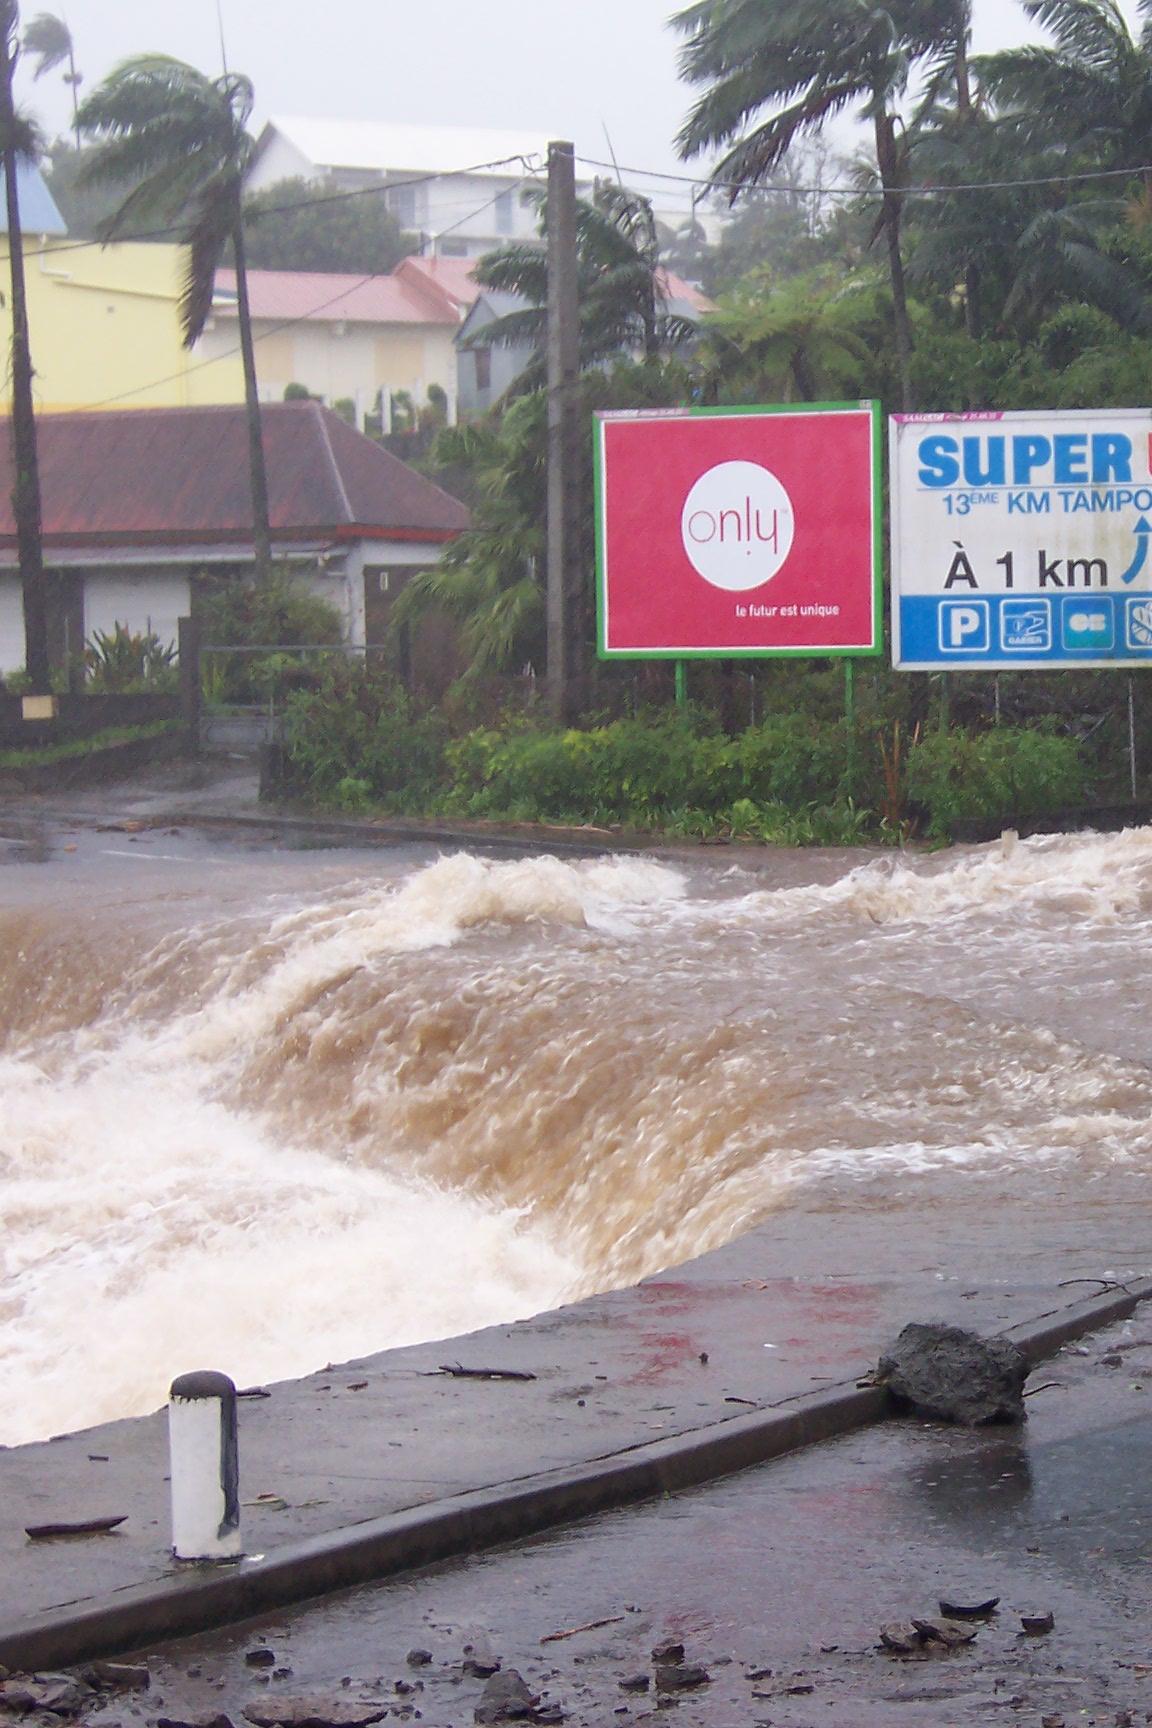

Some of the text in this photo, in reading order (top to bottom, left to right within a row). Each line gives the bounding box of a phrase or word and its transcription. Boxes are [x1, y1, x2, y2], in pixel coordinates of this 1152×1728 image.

[917, 435, 1132, 487] SUPER
[1008, 491, 1050, 513] KM
[688, 496, 777, 556] only
[943, 540, 1108, 589] À 1 km
[736, 602, 840, 618] le futur est unique
[951, 608, 980, 646] P
